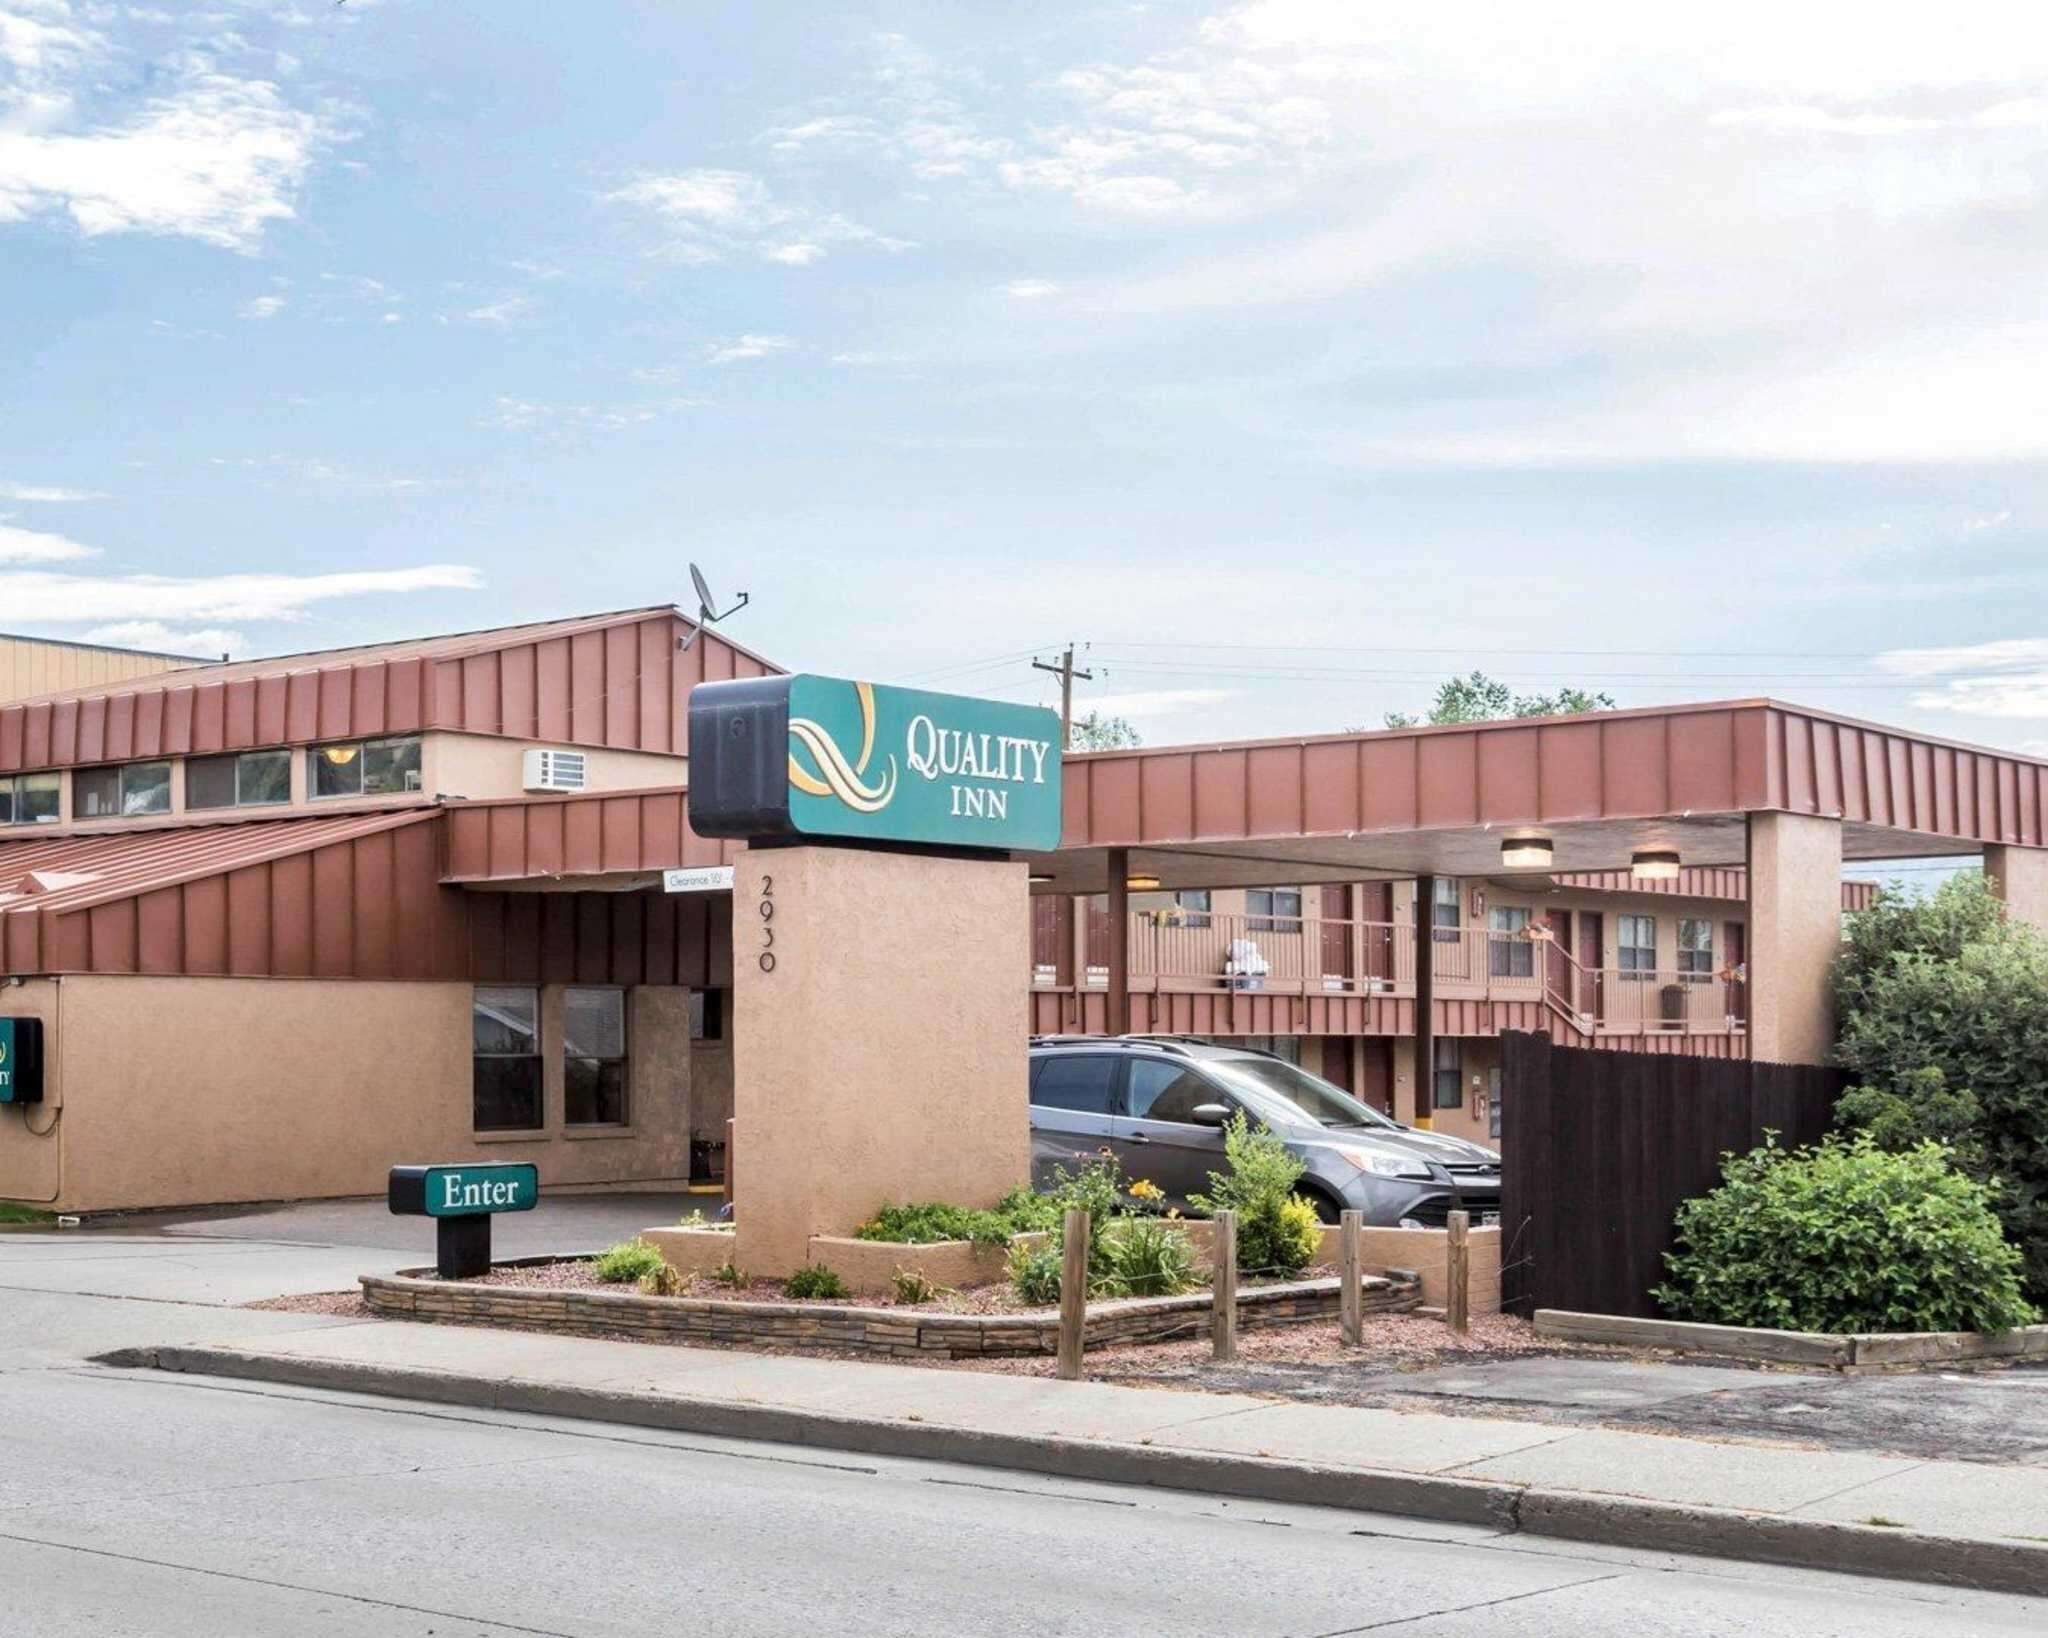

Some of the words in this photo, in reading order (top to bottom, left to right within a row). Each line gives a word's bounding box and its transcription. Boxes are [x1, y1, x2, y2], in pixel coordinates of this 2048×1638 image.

[907, 715, 1050, 784] QUALITY
[951, 785, 1008, 819] INN
[759, 875, 776, 973] 2930
[443, 1174, 519, 1208] Enter
